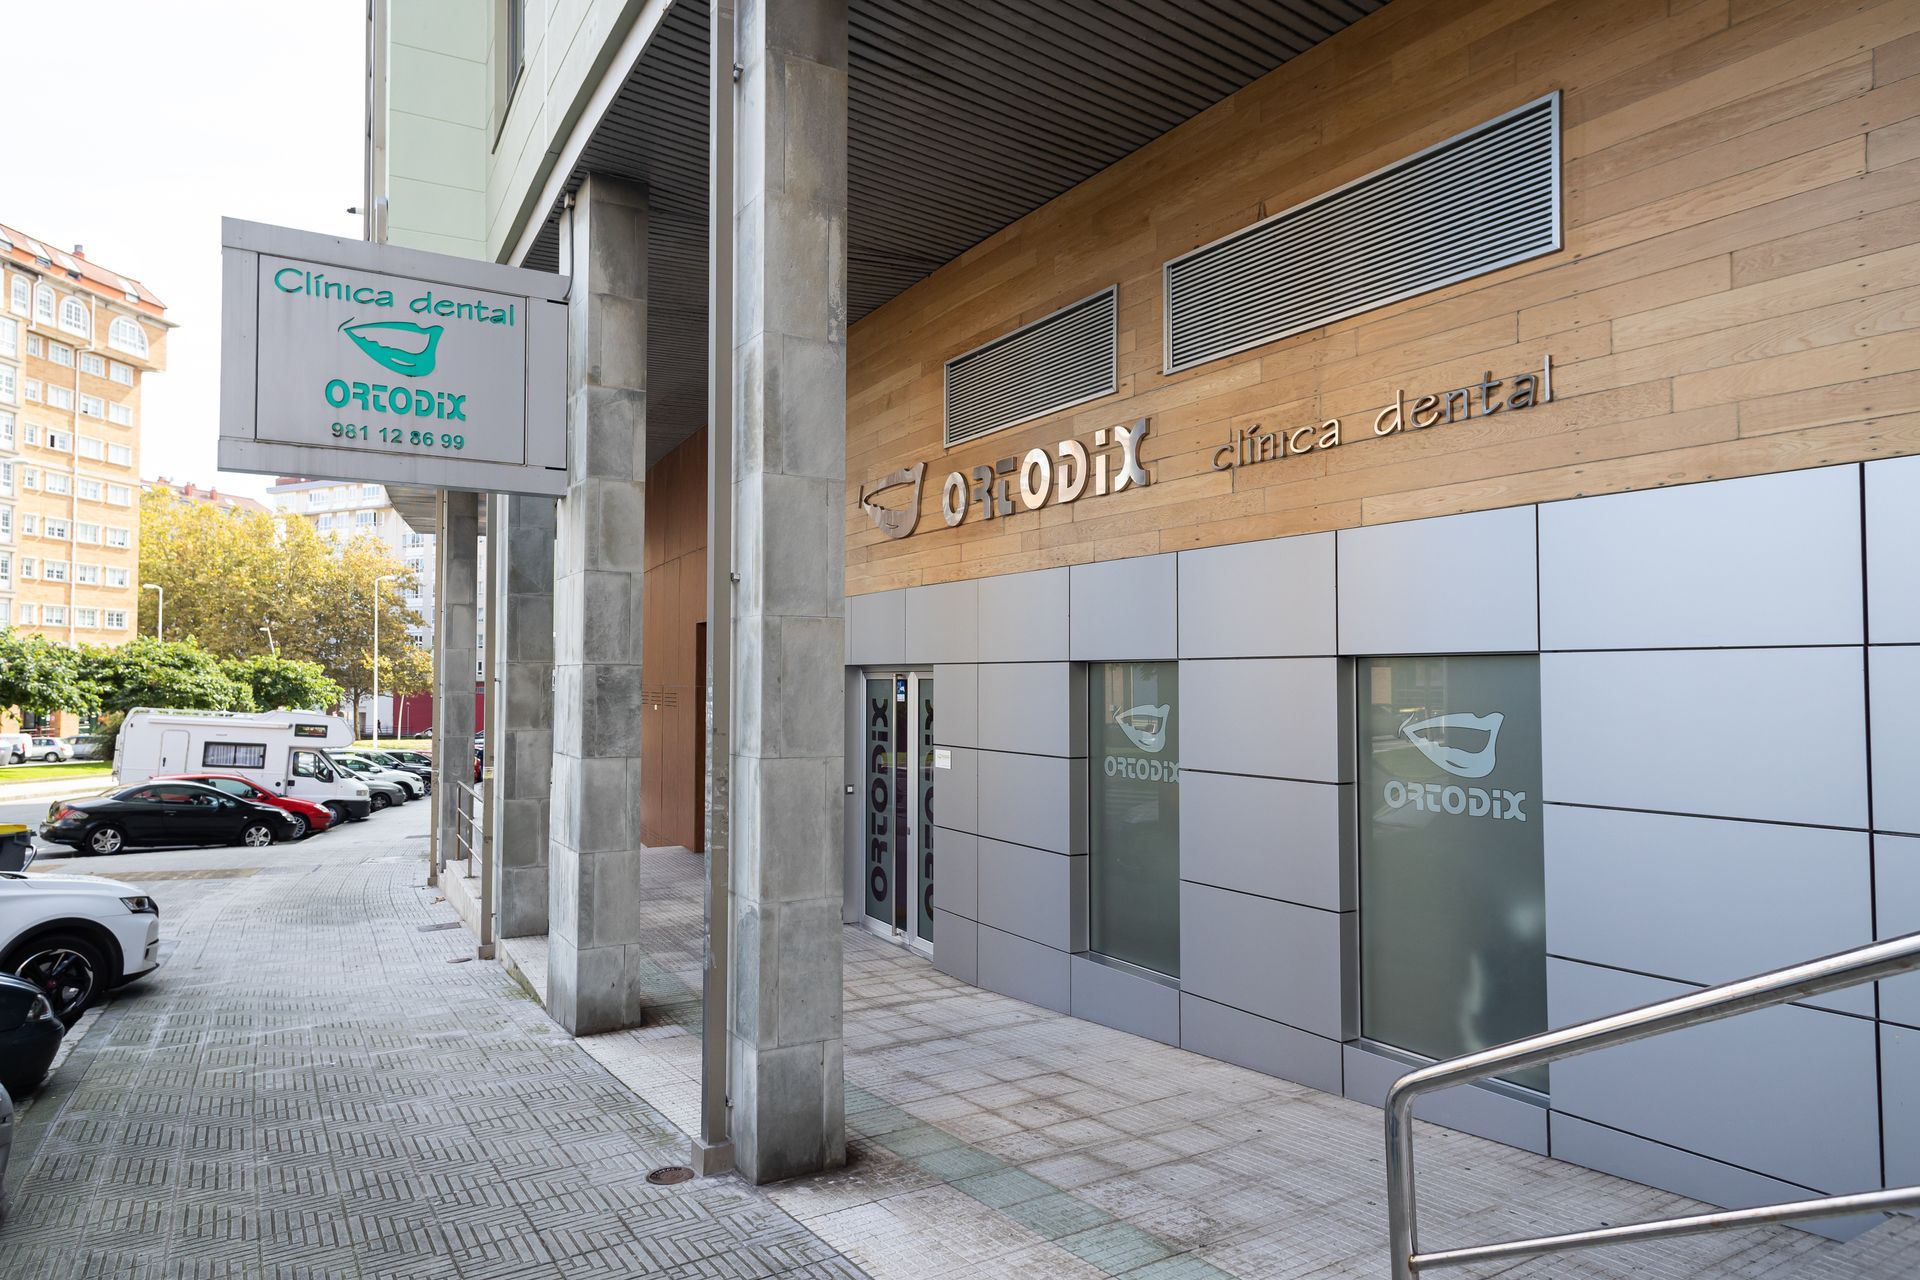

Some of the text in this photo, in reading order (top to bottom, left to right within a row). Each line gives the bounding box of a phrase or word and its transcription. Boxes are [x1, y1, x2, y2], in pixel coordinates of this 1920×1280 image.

[274, 267, 515, 326] Clínica dental
[331, 422, 465, 449] 981 12 86 99
[1211, 418, 1343, 471] clínica
[1373, 354, 1554, 436] dental
